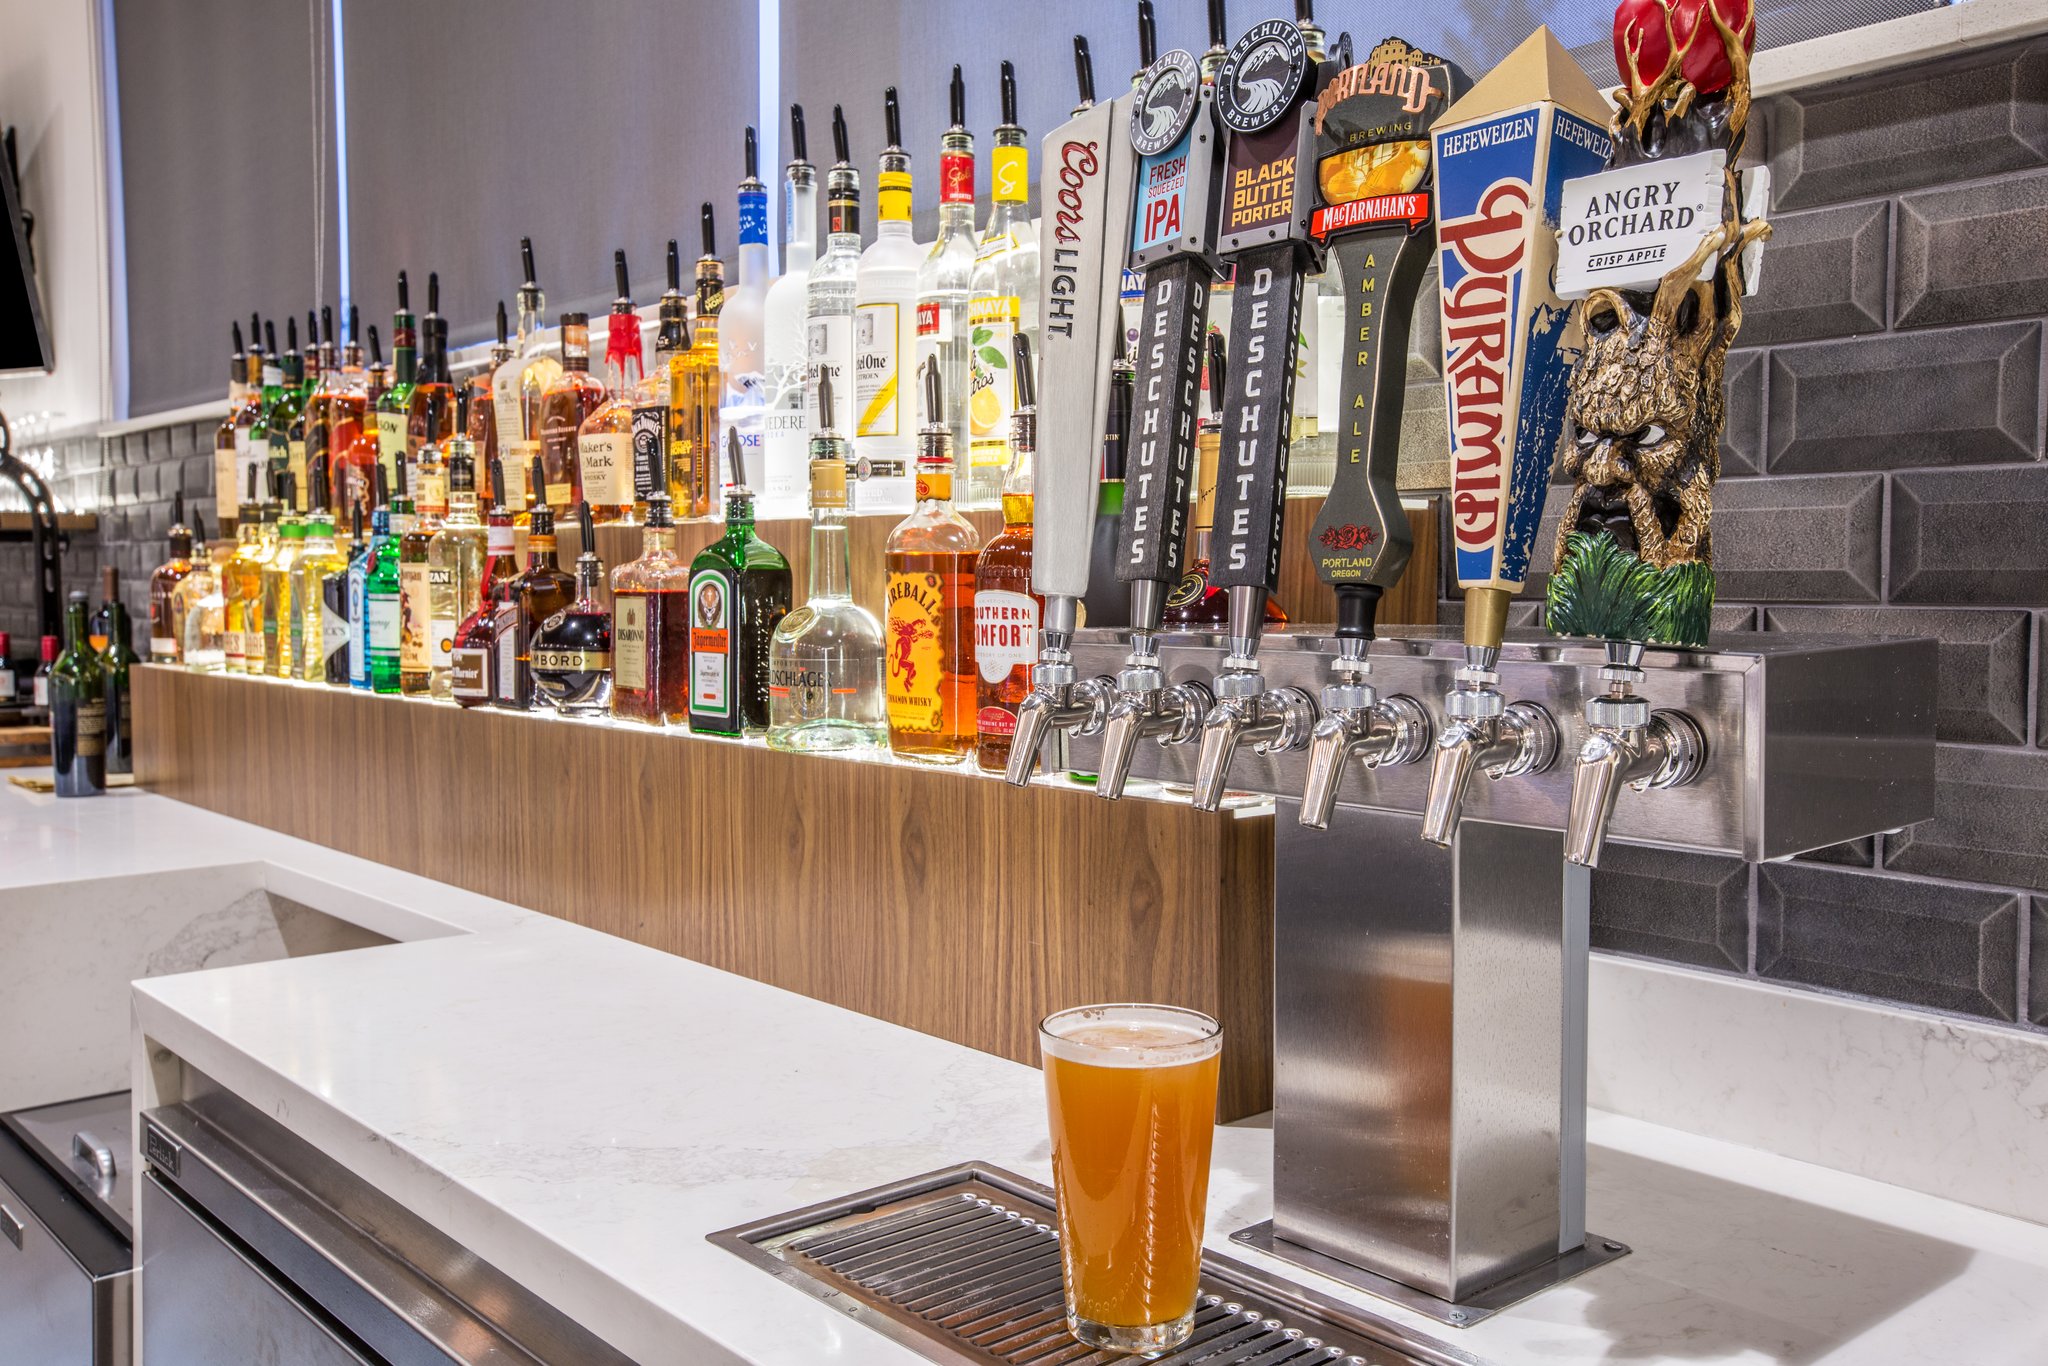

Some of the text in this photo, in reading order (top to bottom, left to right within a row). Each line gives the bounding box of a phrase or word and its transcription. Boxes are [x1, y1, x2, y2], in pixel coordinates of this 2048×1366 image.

[1223, 21, 1303, 76] DESCHUTES
[1134, 52, 1195, 105] DESCHUTES
[1349, 121, 1412, 143] BREWING
[1442, 115, 1535, 158] HEFEWEIZEN
[1555, 114, 1615, 160] HEFEWEIZ
[1147, 176, 1185, 198] SQUEEZED
[1149, 155, 1187, 185] FRESH
[1235, 156, 1296, 189] BLACK
[1233, 176, 1295, 210] BUTTE
[1585, 181, 1681, 219] ANGRY
[1143, 192, 1181, 244] IPA
[1231, 198, 1293, 228] PORTER
[1568, 206, 1695, 247] ORCHARD
[1048, 140, 1099, 340] Coors LIGHT
[1587, 248, 1667, 268] CRISP APPLE
[866, 354, 886, 368] One
[1350, 253, 1377, 464] AMBER ALE
[1439, 183, 1530, 546] PYRAMID
[970, 371, 994, 397] tros
[1130, 278, 1173, 564] DESCHUTES
[1167, 281, 1203, 569] DESCHUTES
[1228, 267, 1273, 570] DESCHUTES
[1270, 272, 1300, 576] DESCHUTES
[1321, 557, 1373, 569] PORTLAND
[1331, 569, 1362, 578] OREGON
[888, 582, 937, 616] IREBALL
[975, 606, 1031, 620] OUTHERN
[975, 623, 1033, 648] OMFORT
[533, 653, 584, 667] MBORD
[908, 695, 933, 707] WHISKY
